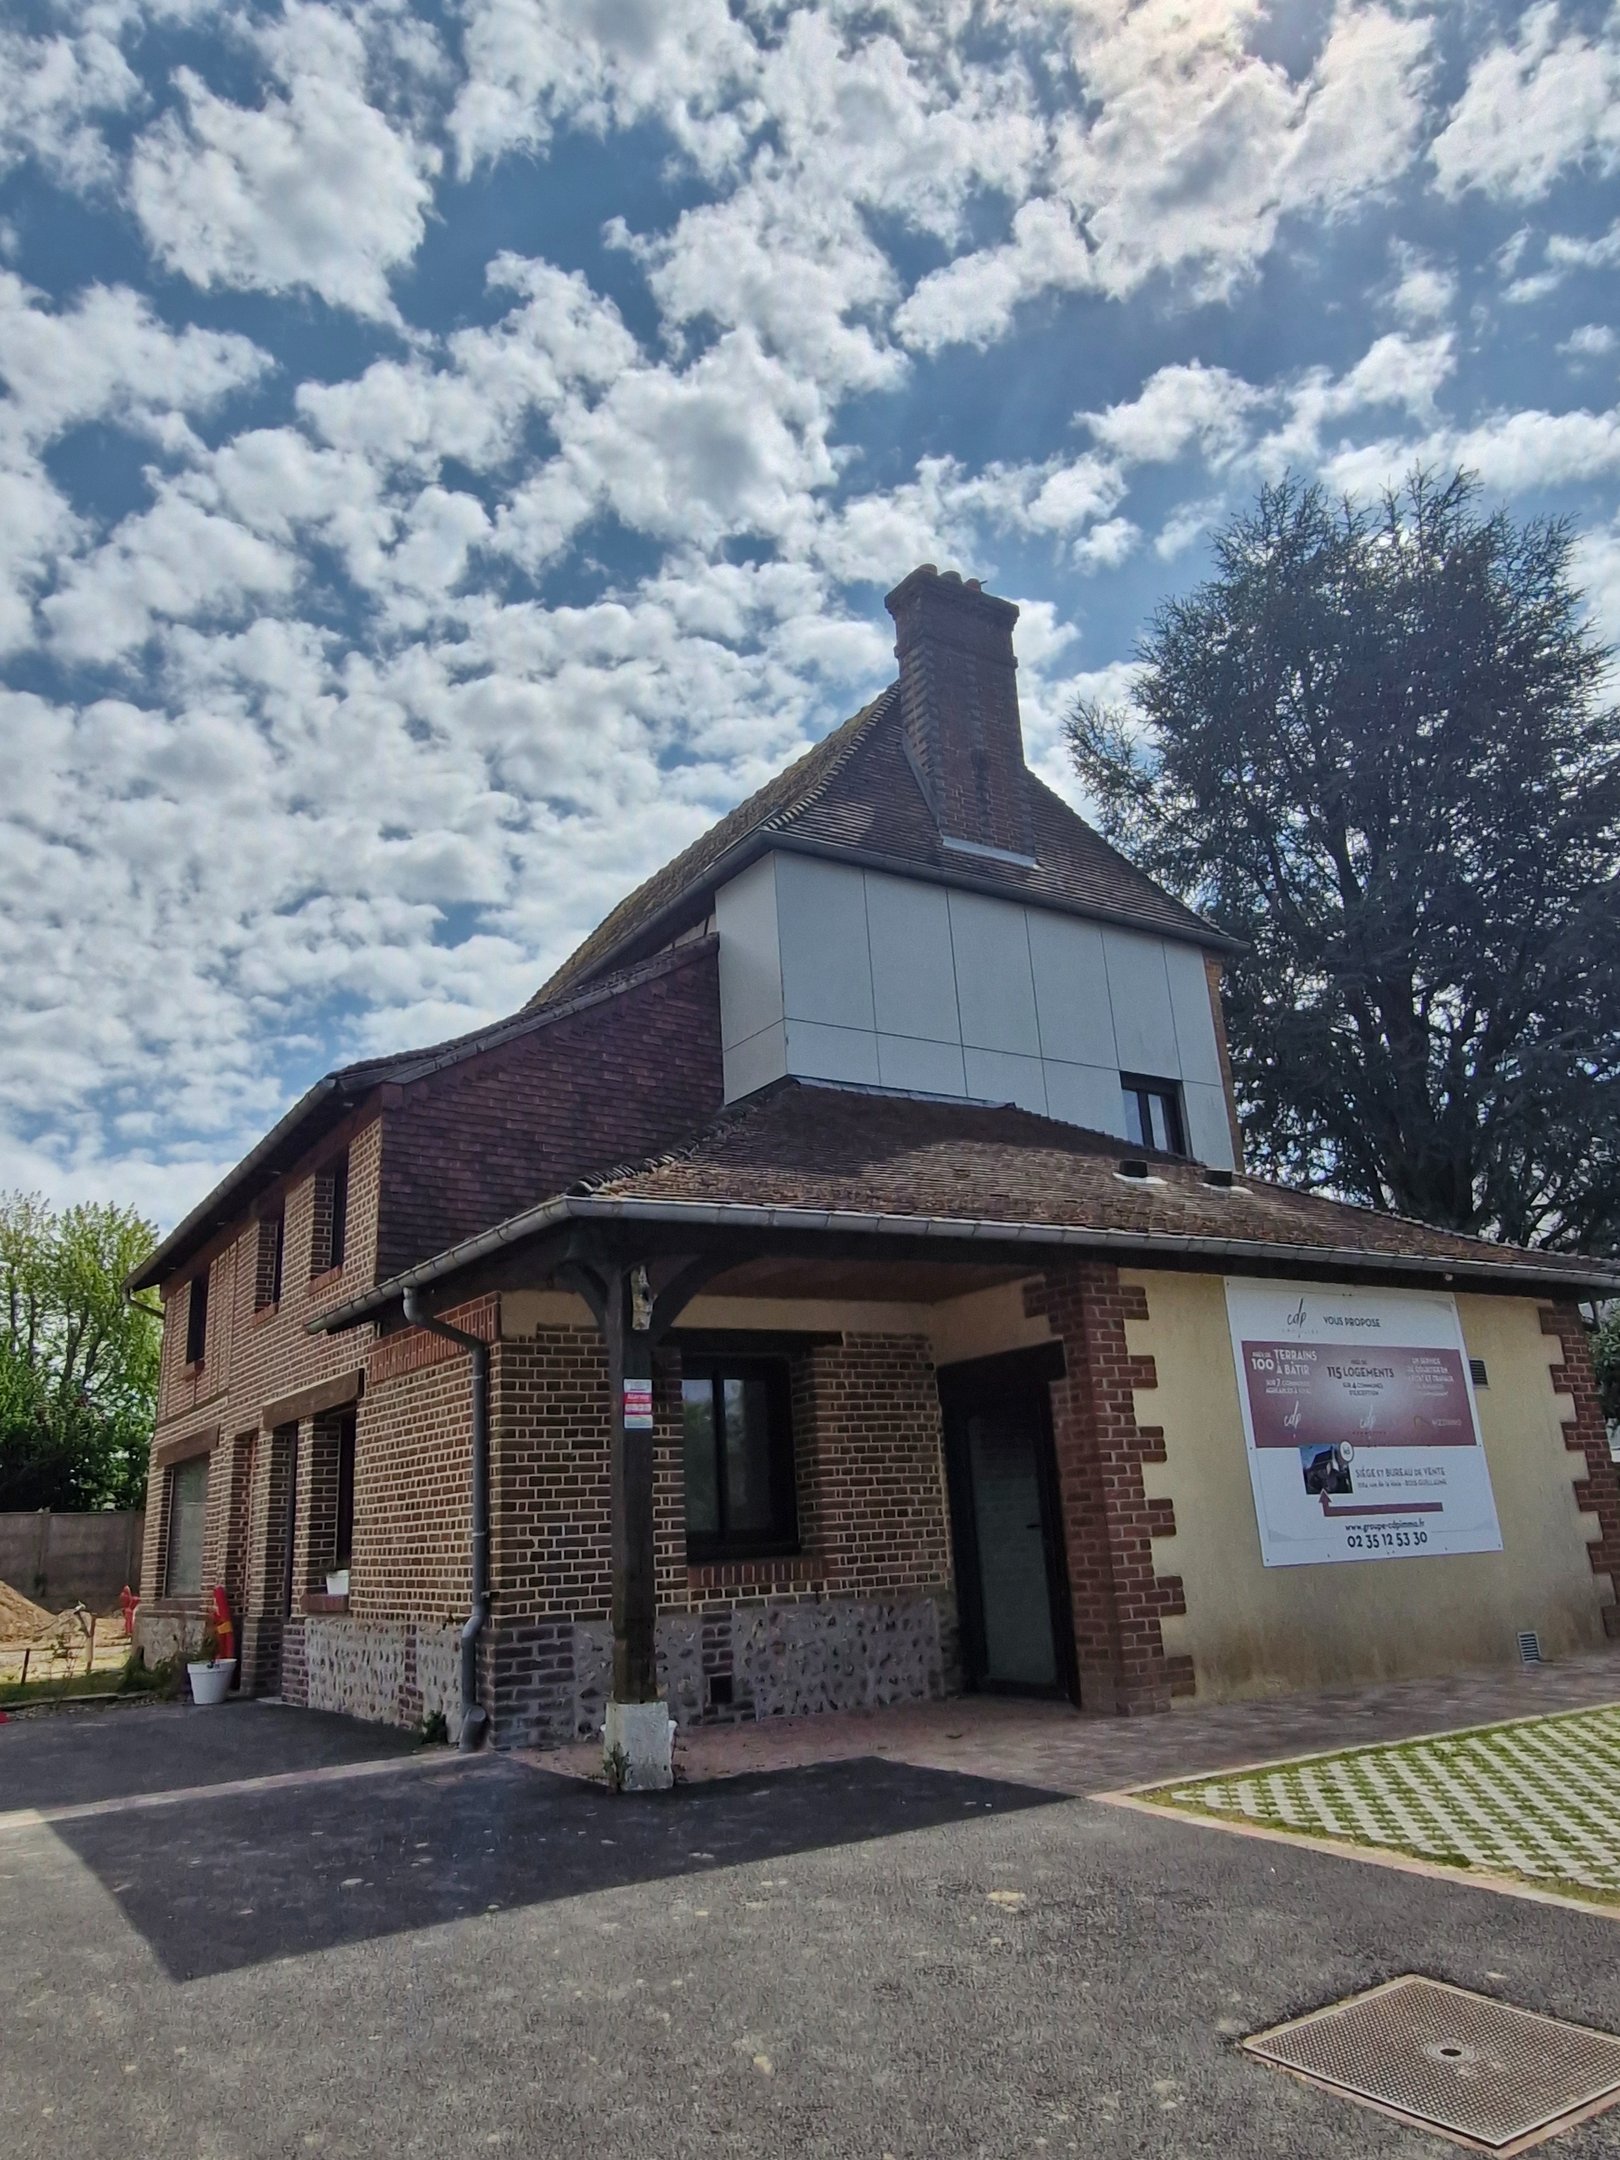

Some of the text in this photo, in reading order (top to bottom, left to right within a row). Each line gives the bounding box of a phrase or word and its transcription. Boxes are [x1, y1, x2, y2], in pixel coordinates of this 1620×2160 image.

[1287, 1298, 1307, 1328] cdp
[1323, 1316, 1381, 1328] VOUS PROPOSE
[1273, 1349, 1317, 1361] TERRAINS
[1252, 1358, 1274, 1370] 100
[1284, 1361, 1310, 1376] BÂTIR
[1327, 1366, 1342, 1380] 115
[1343, 1367, 1394, 1378] LOGEMENTS
[1283, 1400, 1302, 1429] cdp
[1423, 1467, 1445, 1476] VENTE
[1347, 1531, 1428, 1549] 02 35 12 53 30
